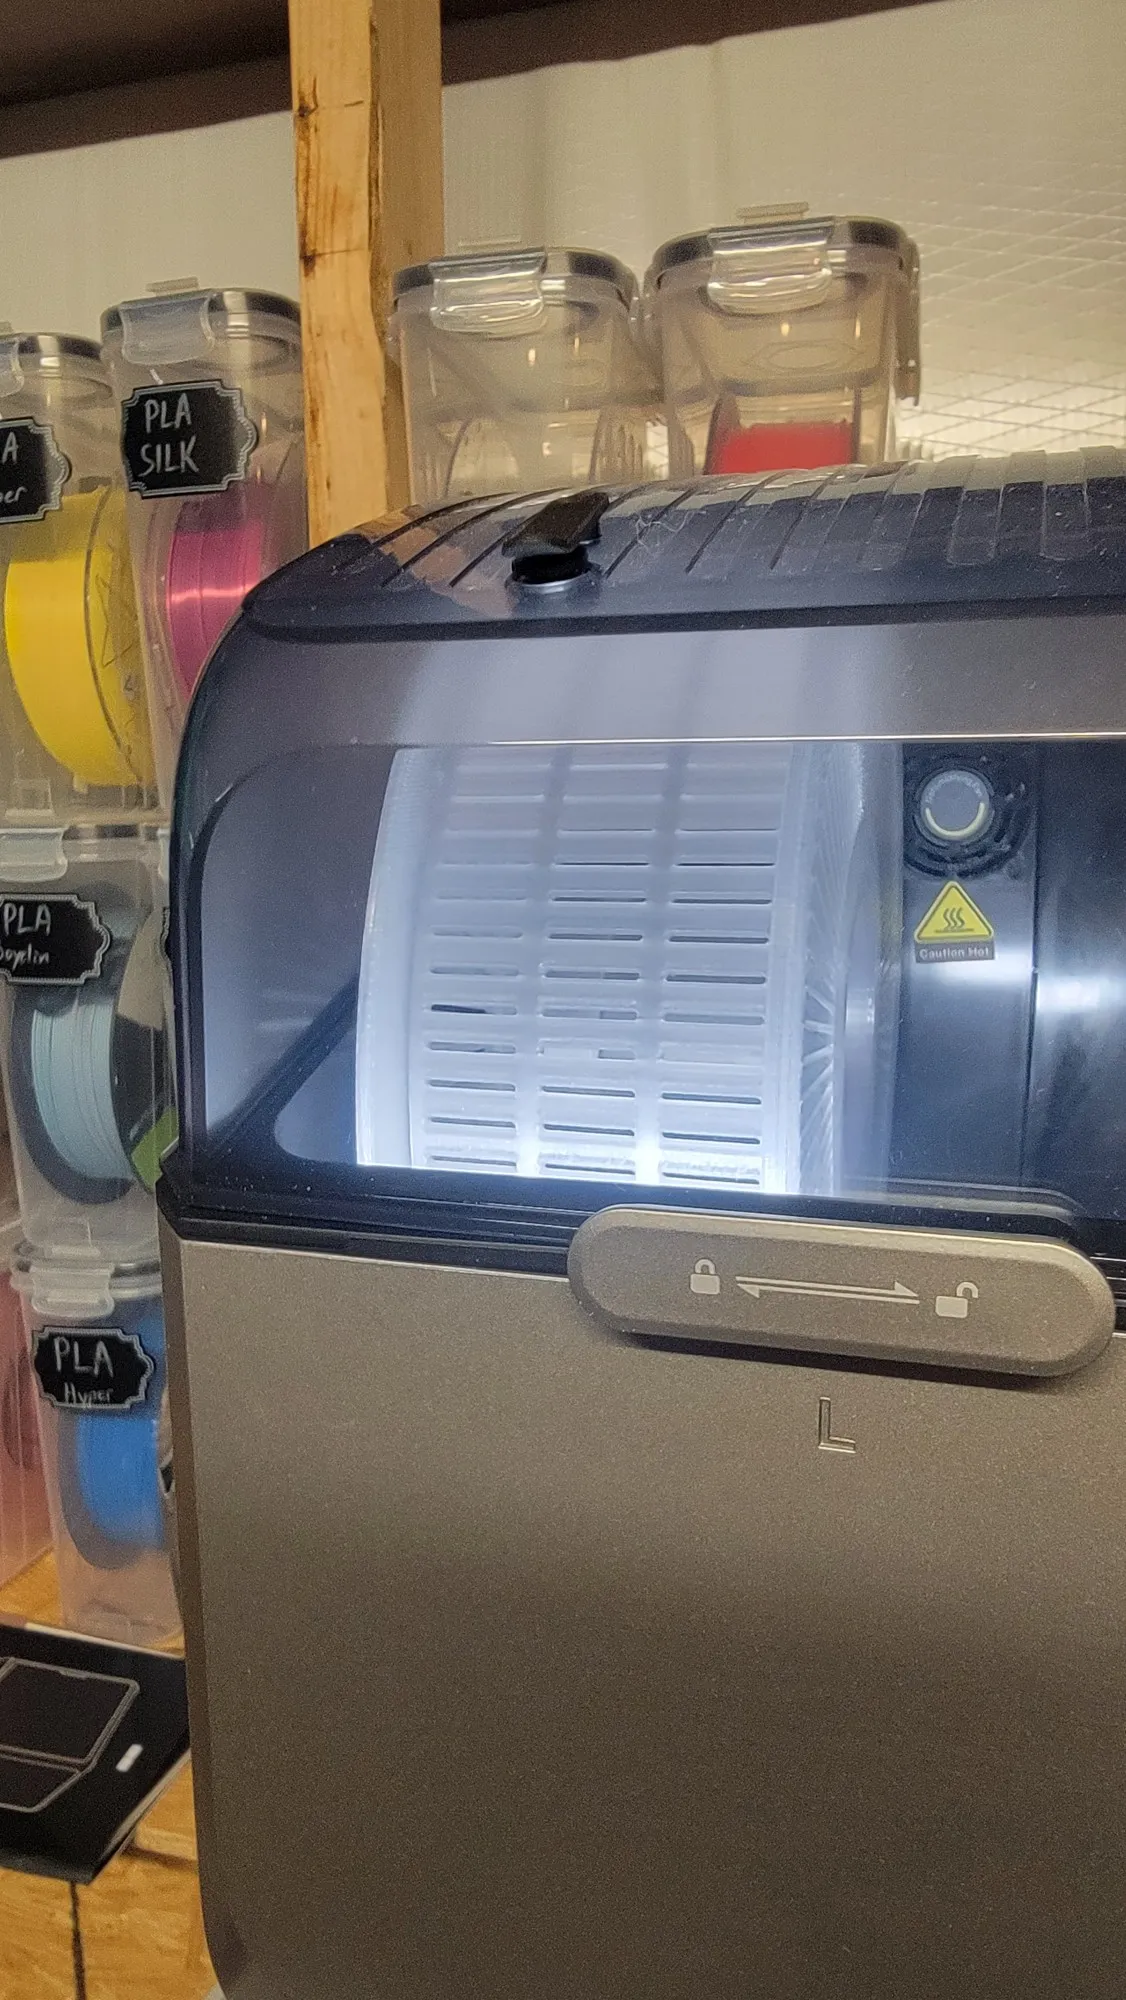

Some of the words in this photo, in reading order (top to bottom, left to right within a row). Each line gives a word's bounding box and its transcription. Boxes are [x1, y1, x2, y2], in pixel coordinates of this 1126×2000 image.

[144, 393, 193, 433] PLA
[138, 436, 200, 477] SILK
[3, 902, 52, 937] PLA
[919, 947, 965, 960] Caution
[968, 947, 989, 958] Hot
[53, 1336, 114, 1378] PLA
[64, 1382, 114, 1409] Hyper
[818, 1396, 856, 1454] L
